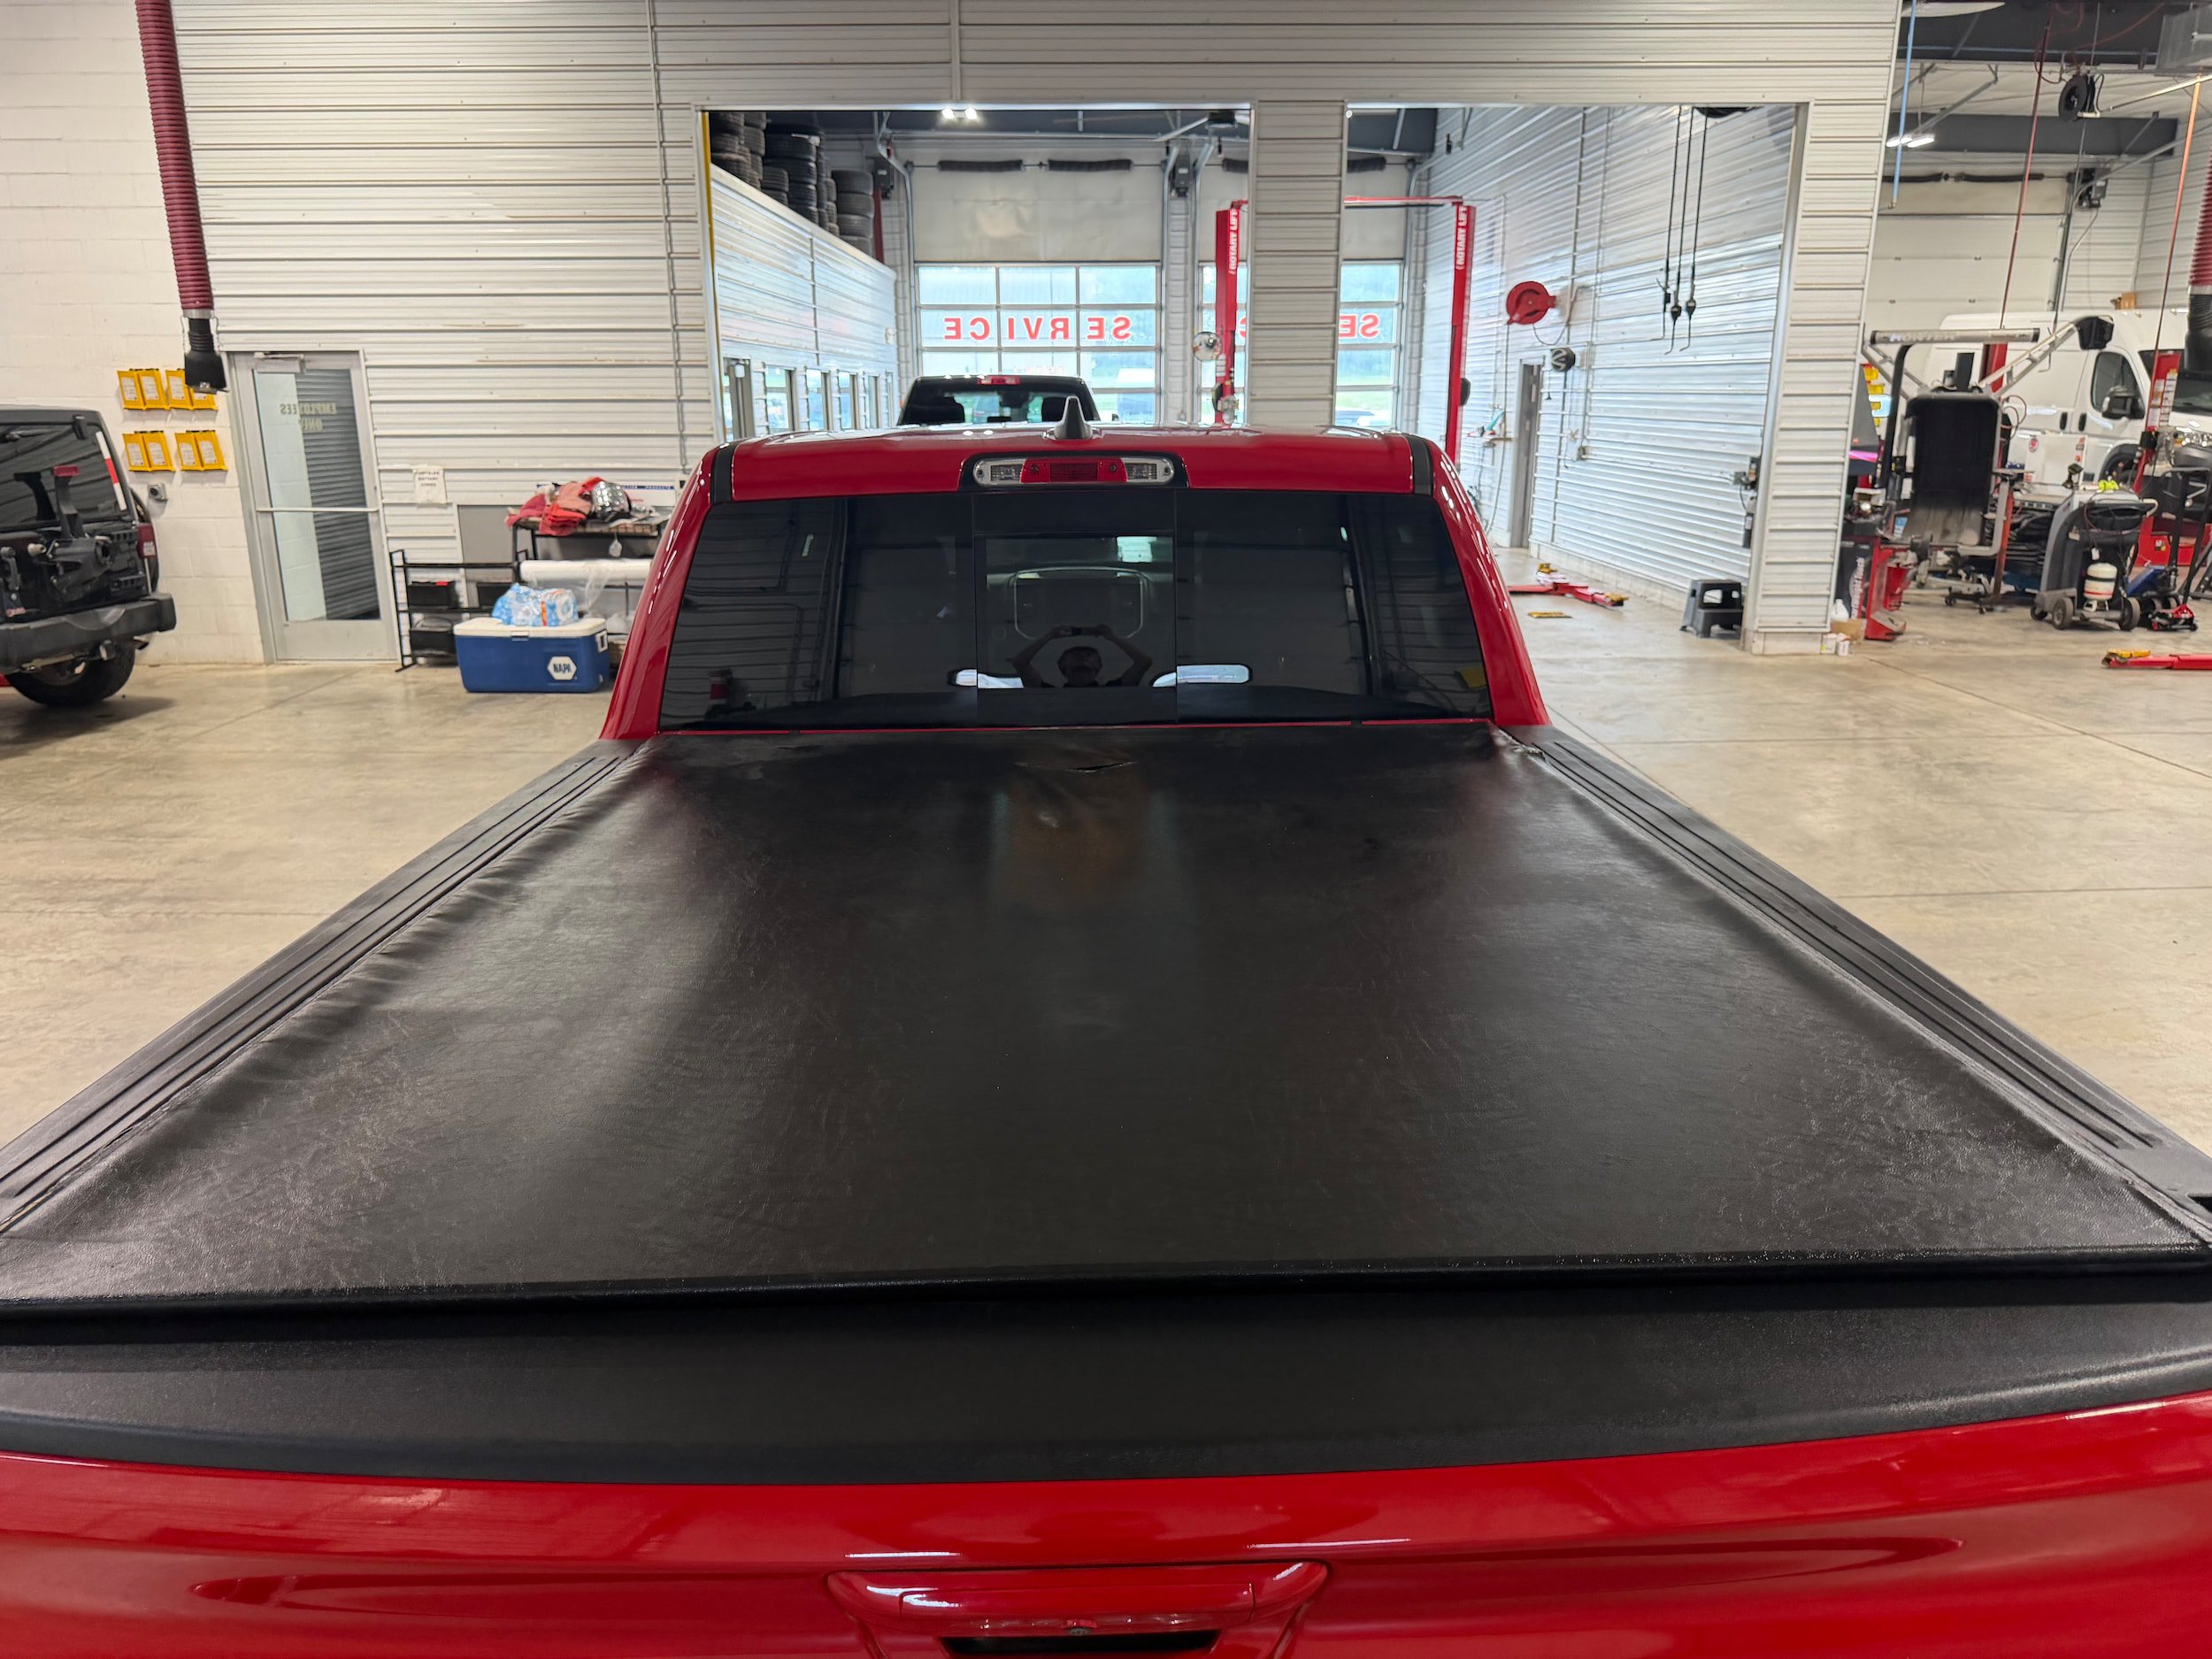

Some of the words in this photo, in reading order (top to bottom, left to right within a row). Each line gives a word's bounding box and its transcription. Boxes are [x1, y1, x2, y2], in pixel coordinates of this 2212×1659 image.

[1458, 205, 1468, 227] LIFT
[1228, 232, 1237, 270] ROTARY
[1455, 228, 1466, 265] ROTARY
[553, 663, 572, 673] NAPA
